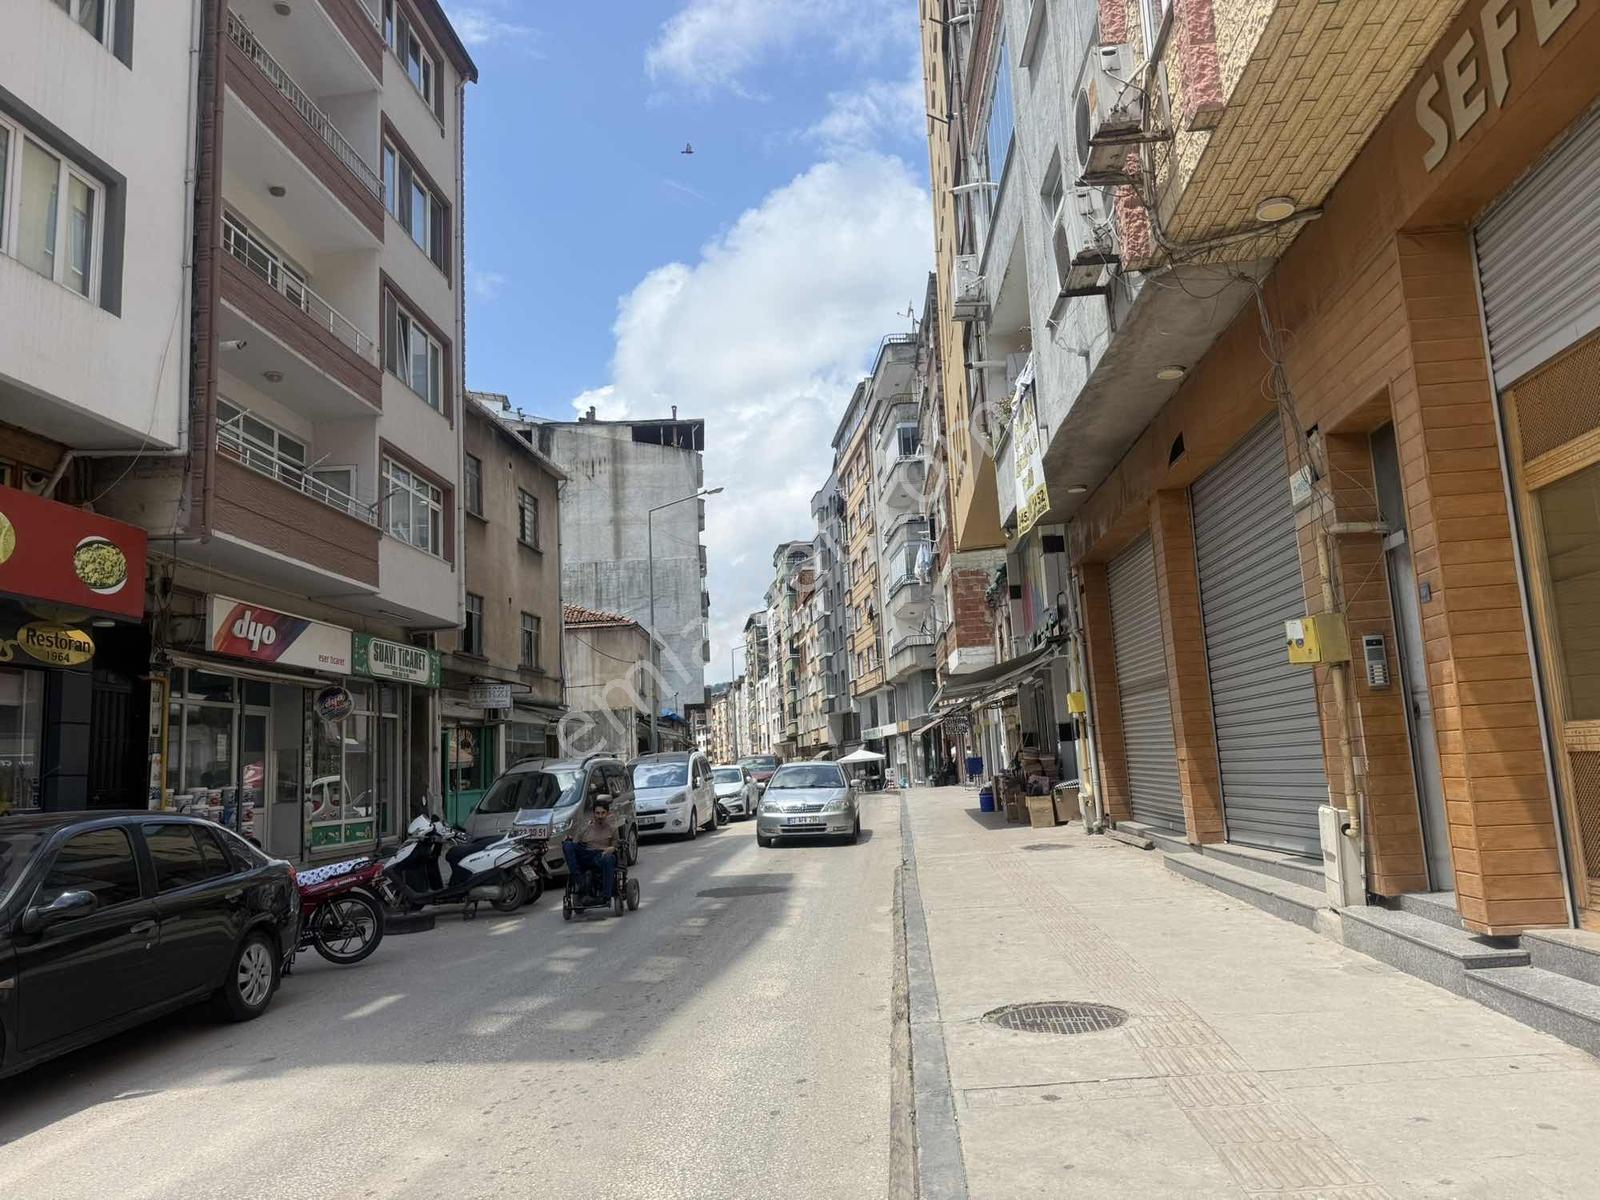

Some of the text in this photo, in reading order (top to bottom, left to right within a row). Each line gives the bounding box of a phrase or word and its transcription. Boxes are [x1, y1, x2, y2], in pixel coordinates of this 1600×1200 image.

[26, 627, 91, 653] Restoran
[232, 610, 277, 652] dyo
[46, 650, 70, 663] 1964
